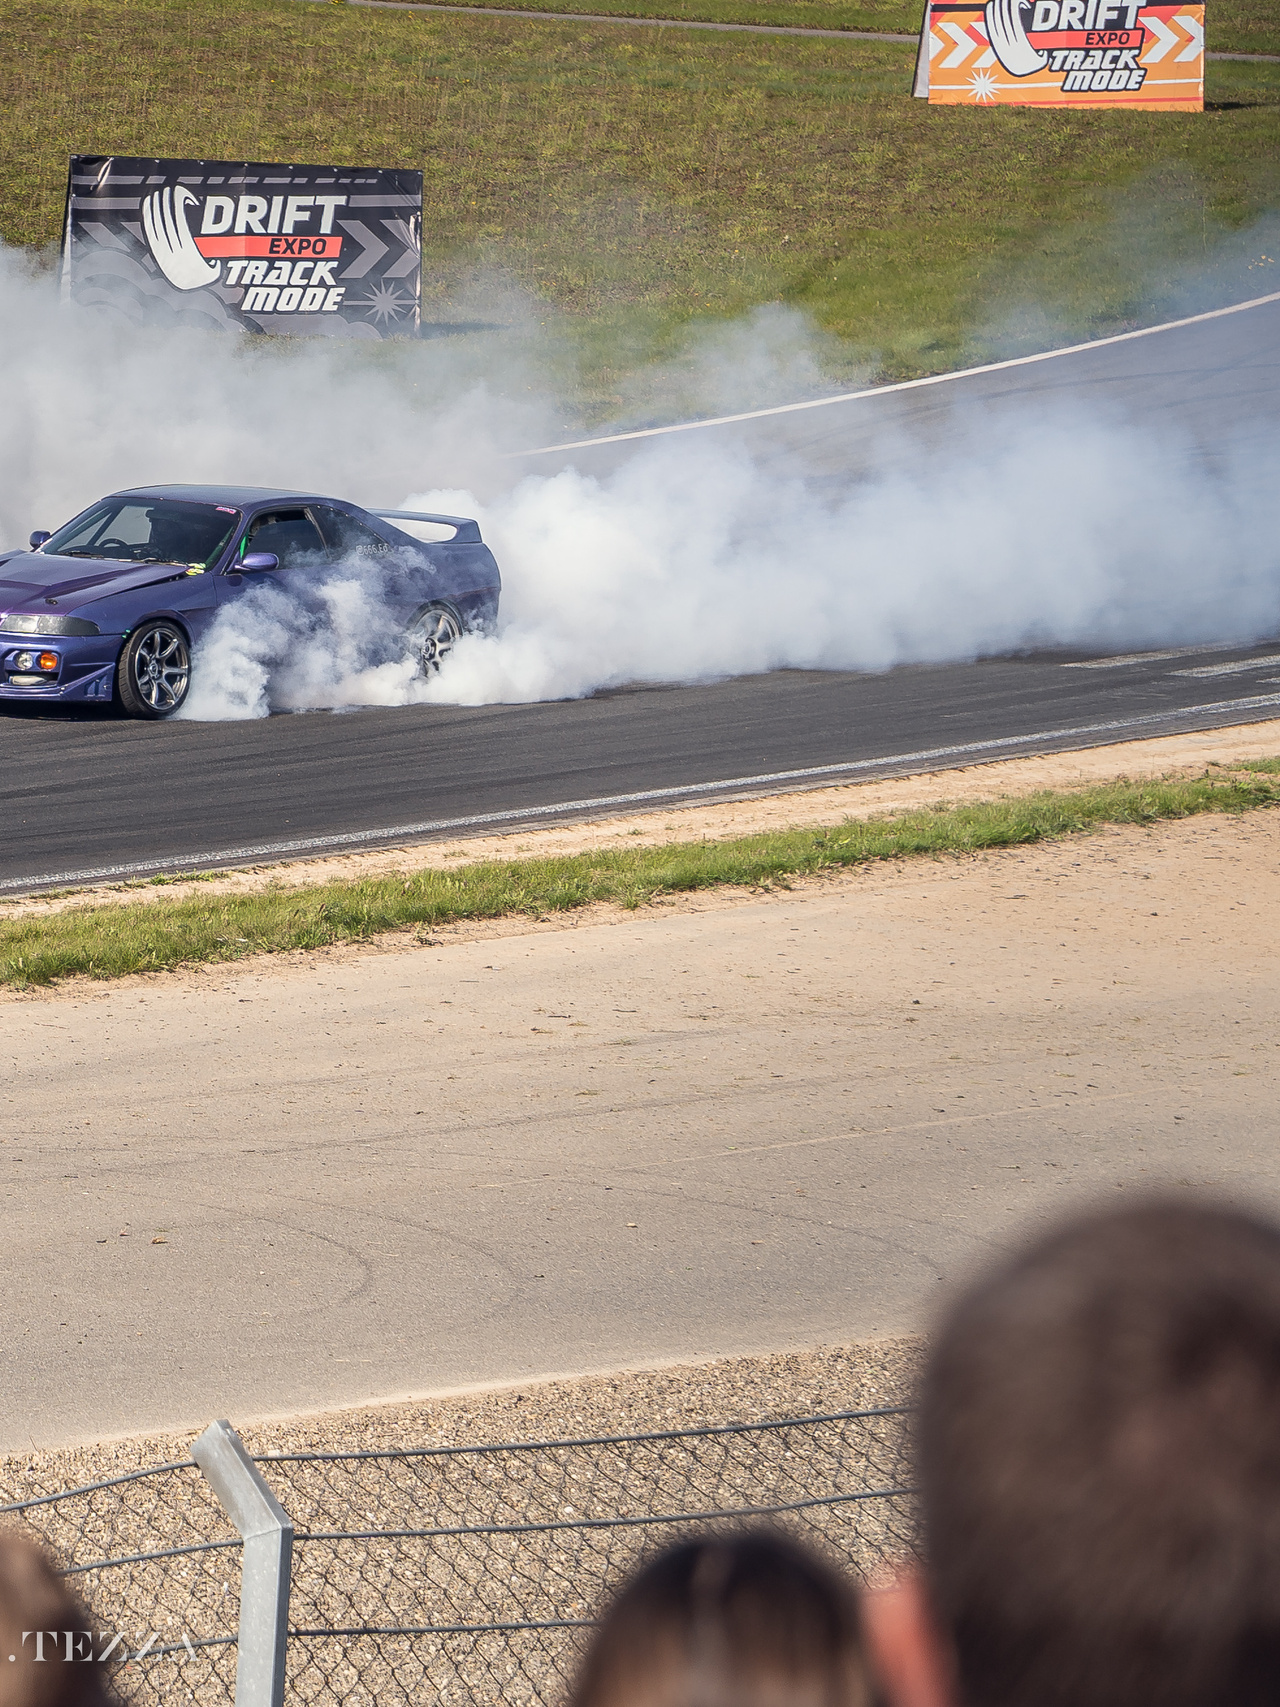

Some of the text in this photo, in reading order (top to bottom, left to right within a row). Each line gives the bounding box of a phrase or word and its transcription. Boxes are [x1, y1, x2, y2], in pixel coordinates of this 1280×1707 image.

[1031, 0, 1147, 30] DRIFT
[1085, 32, 1130, 45] EXPO
[1051, 49, 1140, 70] TRACK
[1061, 70, 1146, 91] MODE
[200, 195, 348, 235] DRIFT
[269, 238, 327, 255] EXPO
[225, 260, 339, 286] TRACK
[241, 287, 346, 311] MODE
